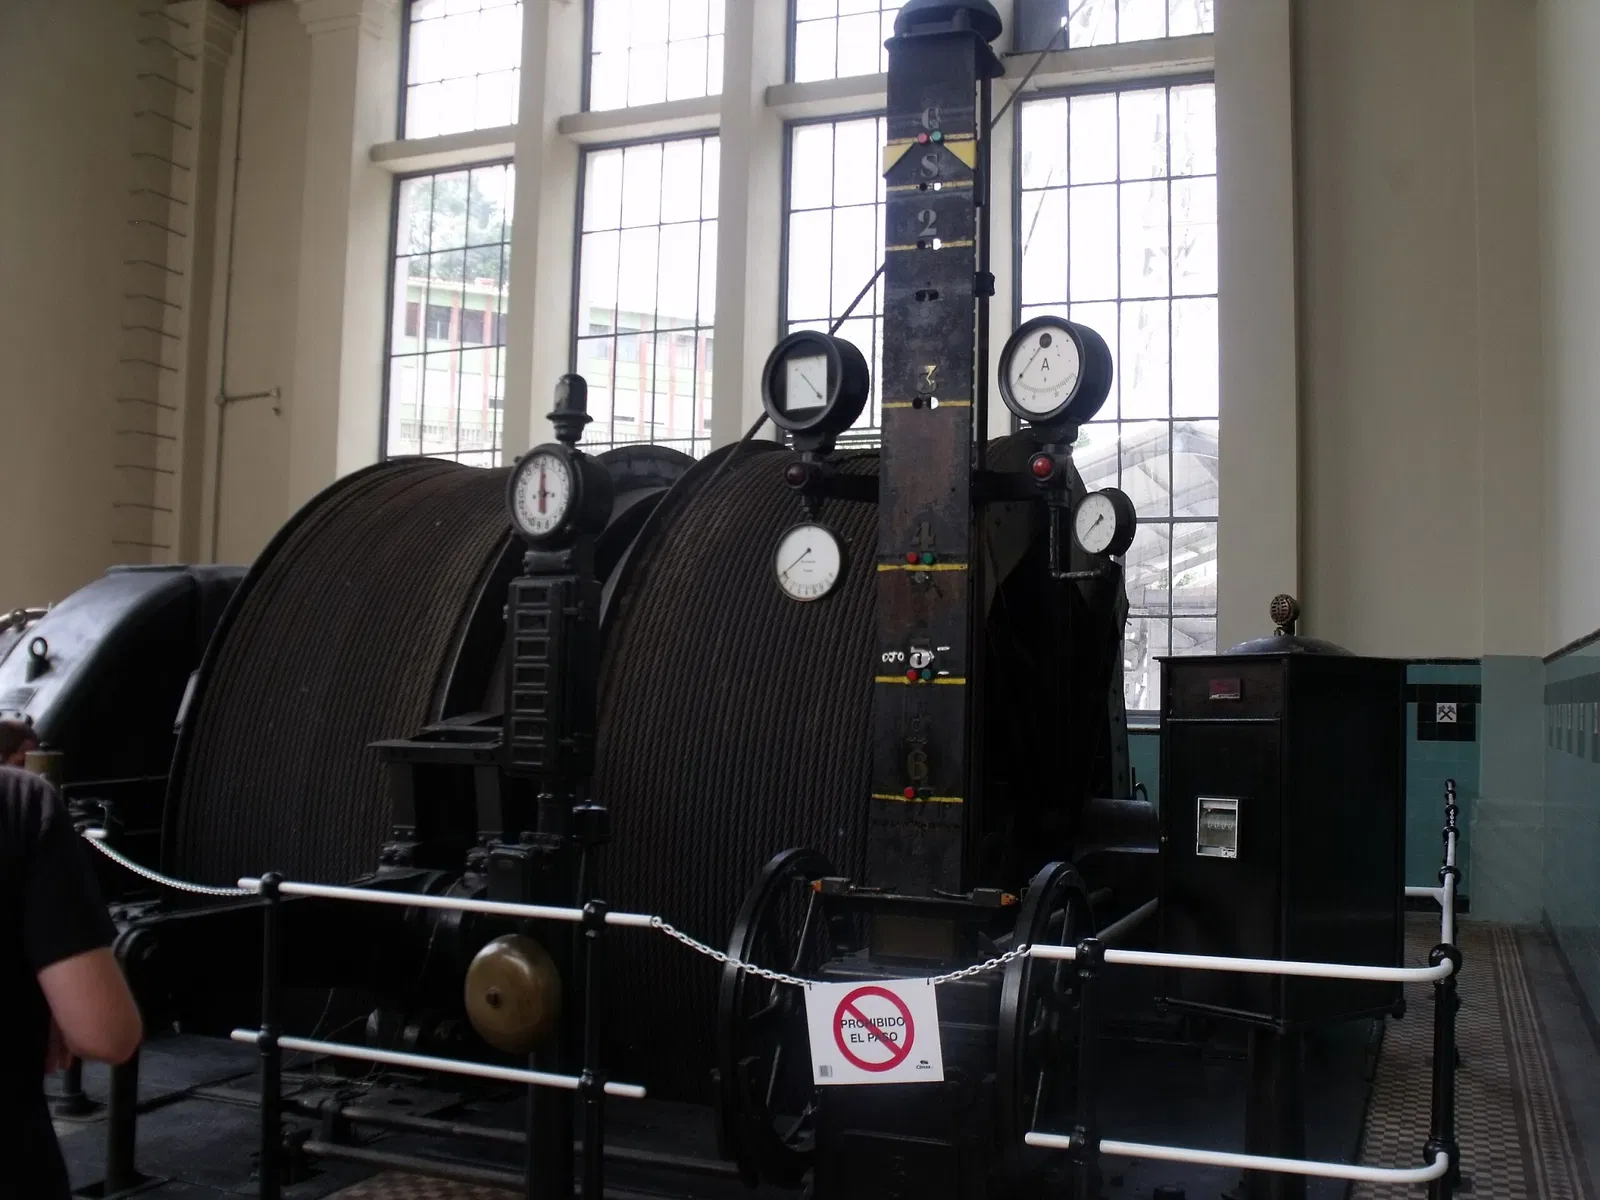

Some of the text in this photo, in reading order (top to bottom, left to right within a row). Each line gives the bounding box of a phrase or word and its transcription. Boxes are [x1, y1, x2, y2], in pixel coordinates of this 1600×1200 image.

[917, 209, 937, 237] 2
[1041, 358, 1050, 371] A
[841, 1016, 906, 1029] PROHIBIDO
[850, 1032, 898, 1043] EL PASO
